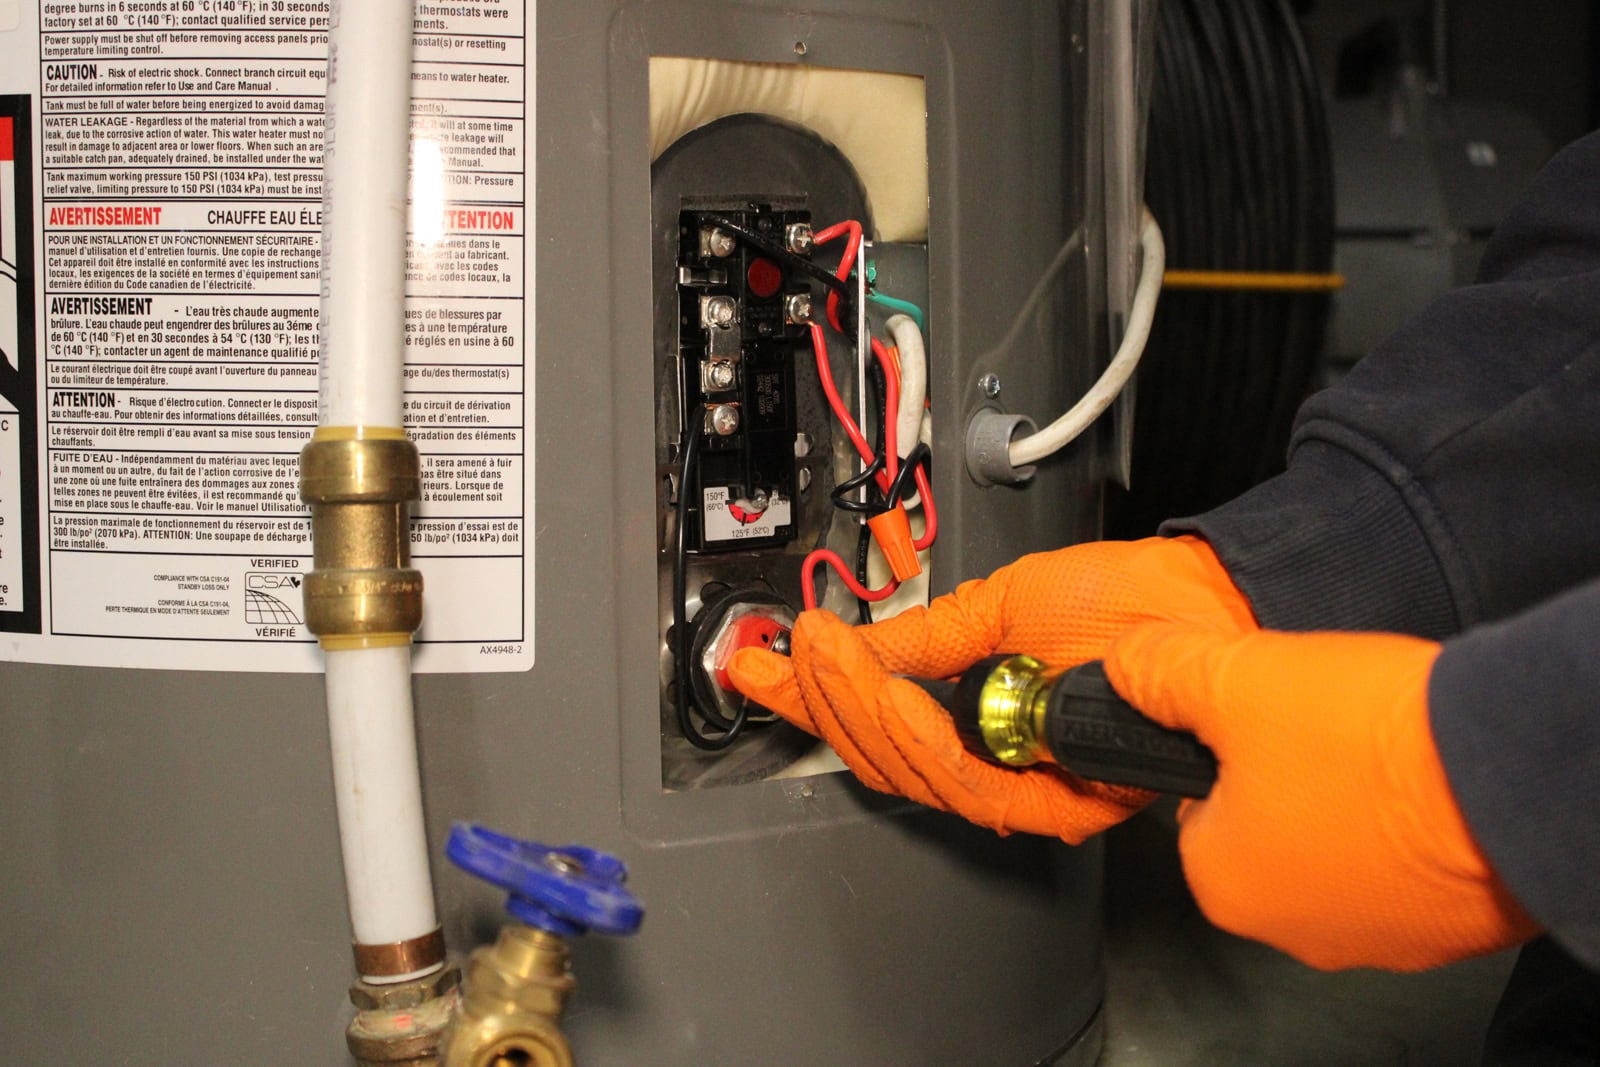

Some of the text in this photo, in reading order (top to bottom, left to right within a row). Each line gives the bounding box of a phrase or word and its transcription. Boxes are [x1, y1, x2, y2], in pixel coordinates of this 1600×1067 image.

[44, 3, 76, 16] degree
[79, 2, 105, 13] burns
[108, 1, 116, 12] in
[119, 1, 125, 12] 6
[128, 1, 167, 12] seconds
[170, 1, 179, 11] at
[182, 0, 194, 11] 60
[259, 1, 269, 11] in
[271, 0, 284, 11] 30
[287, 1, 329, 12] seconds
[419, 4, 508, 18] thermostats were
[466, 38, 506, 51] resetting
[46, 64, 306, 80] CAUTION Risk of electric shock. Connect branch circuit
[439, 72, 510, 84] to water heater.
[45, 116, 128, 127] WATER LEAKAGE
[440, 120, 455, 129] will
[457, 121, 466, 130] at
[468, 122, 492, 131] some
[493, 122, 513, 132] time
[452, 133, 504, 144] leakage will
[499, 146, 516, 156] that
[448, 157, 484, 167] Manual.
[474, 176, 514, 186] Pressure
[49, 206, 162, 225] AVERTISSEMENT
[207, 210, 296, 225] CHAUFFE EAU
[48, 235, 313, 246] POUR UNE INSTALLATION ET UN FONCTIONNEMENT SÉCURITAIRE
[468, 239, 500, 249] dans le
[468, 250, 509, 260] fabricant.
[457, 261, 499, 271] les codes
[440, 272, 511, 283] codes locaux, la
[51, 297, 153, 315] AVERTISSEMENT
[425, 309, 502, 322] de blessures par
[51, 318, 313, 332] brûlure. L'eau chaude peut engendrer des brûlures au 3éme
[419, 322, 508, 336] à une température
[414, 335, 514, 348] réglés en usine à 60
[421, 368, 510, 380] du/des thermostat(s)
[53, 392, 115, 407] ATTENTION
[411, 400, 511, 410] du circuit de dérivation
[428, 413, 490, 423] et d'entretien.
[52, 436, 95, 446] chauffants.
[457, 431, 516, 440] des éléments
[53, 452, 113, 463] FUITE D'EAU
[427, 458, 433, 466] il
[457, 458, 487, 467] amené
[489, 458, 495, 467] à
[497, 458, 512, 467] fuir
[436, 469, 501, 478] être situé dans
[455, 481, 504, 491] Lorsque de
[424, 492, 502, 501] à écoulement soit
[706, 492, 724, 501] 150°F
[417, 521, 518, 532] pression d'essai est de
[732, 526, 770, 537] 125°F (52°C)
[54, 526, 307, 543] 300 lb/po² (2070 kPa). ATTENTION: Une soupape de décharge
[424, 533, 518, 544] lb/po² (1034 kPa) doit
[54, 538, 108, 549] être installée.
[250, 559, 299, 568] VERIFIED
[248, 575, 294, 589] CSA
[255, 626, 296, 637] VÉRIFIÉ
[480, 645, 522, 654] AX4948-2
